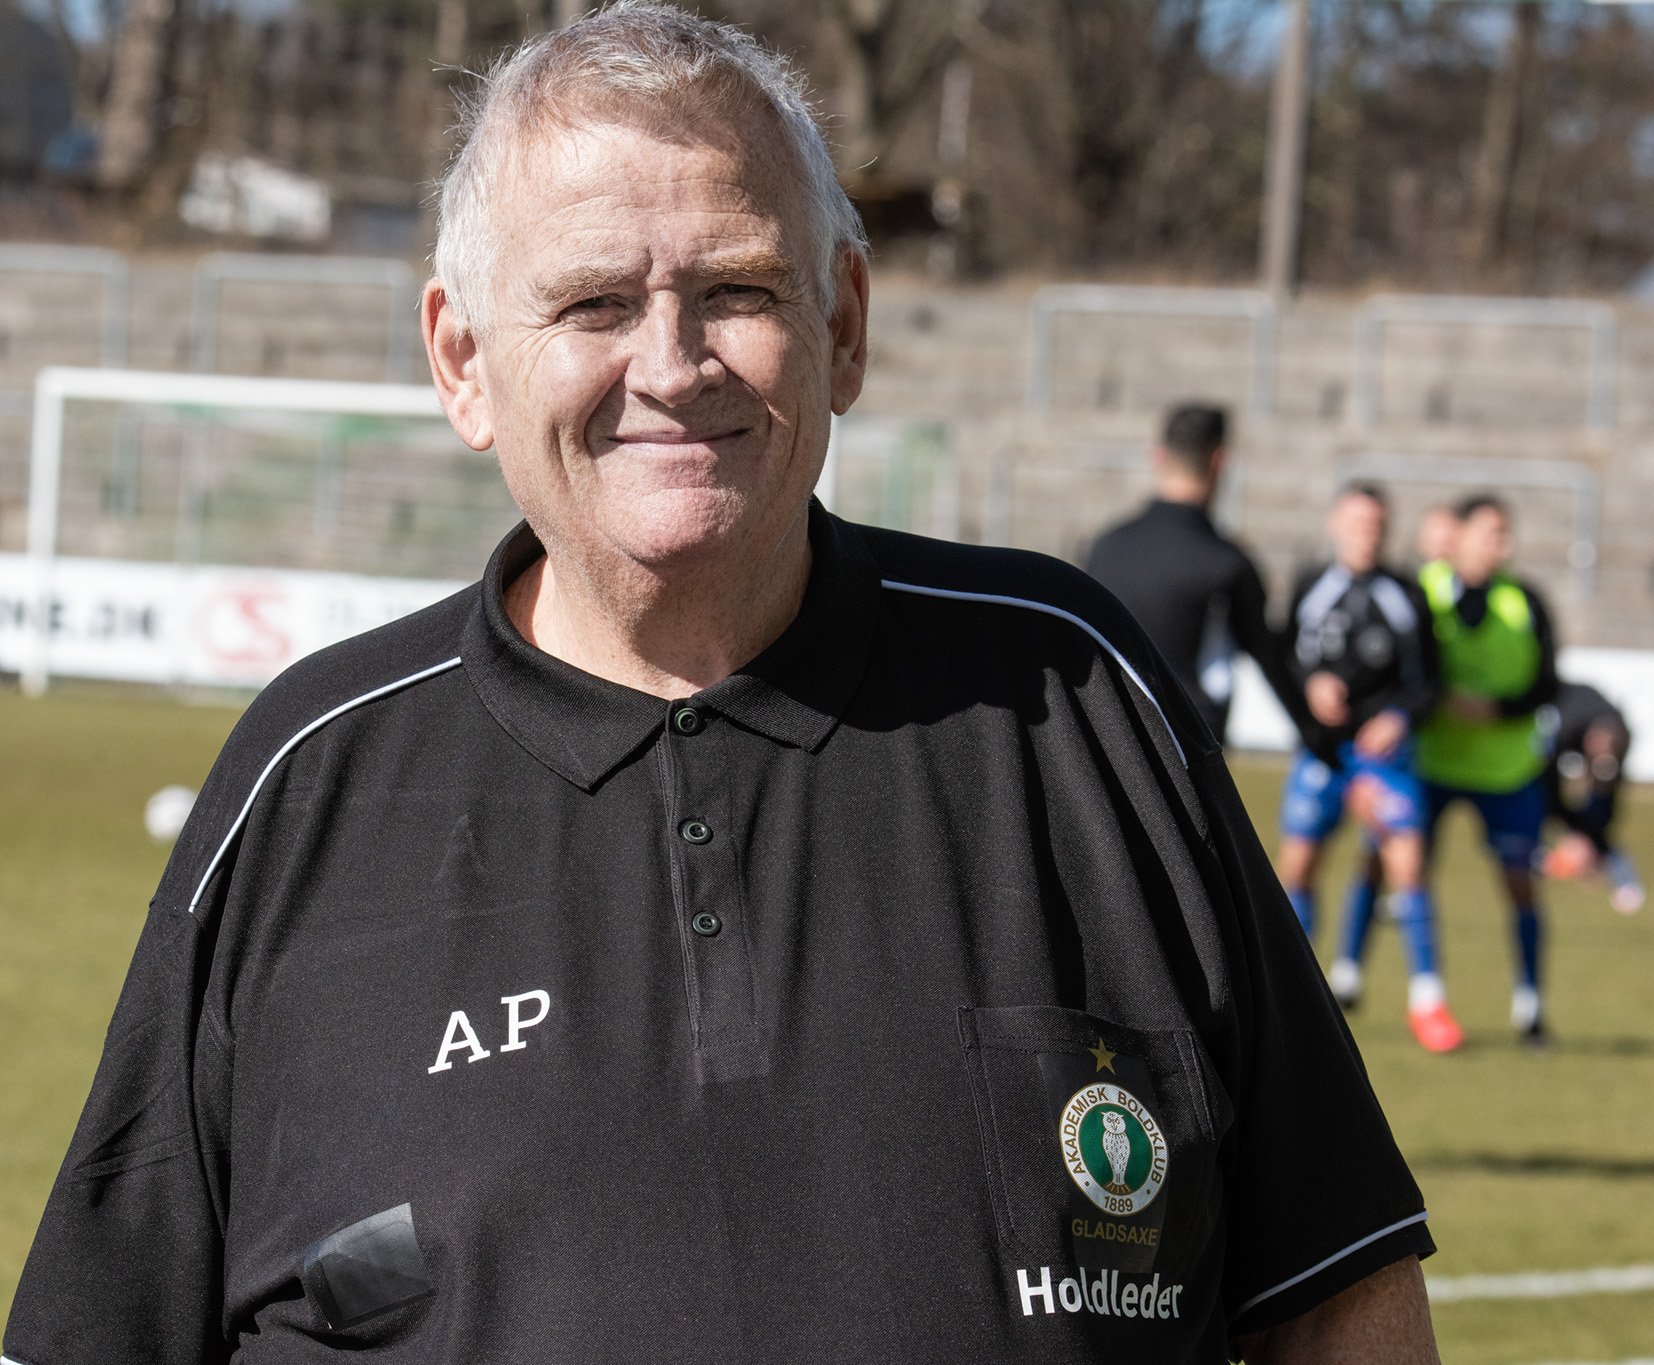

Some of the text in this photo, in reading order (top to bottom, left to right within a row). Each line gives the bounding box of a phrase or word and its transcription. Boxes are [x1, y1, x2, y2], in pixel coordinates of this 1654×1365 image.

[1064, 1087, 1166, 1184] AKADEMISK BOLDKLUB
[1104, 1195, 1133, 1212] 1889
[1072, 1218, 1158, 1246] GLADSAXE
[1017, 1266, 1183, 1319] Holdleder
